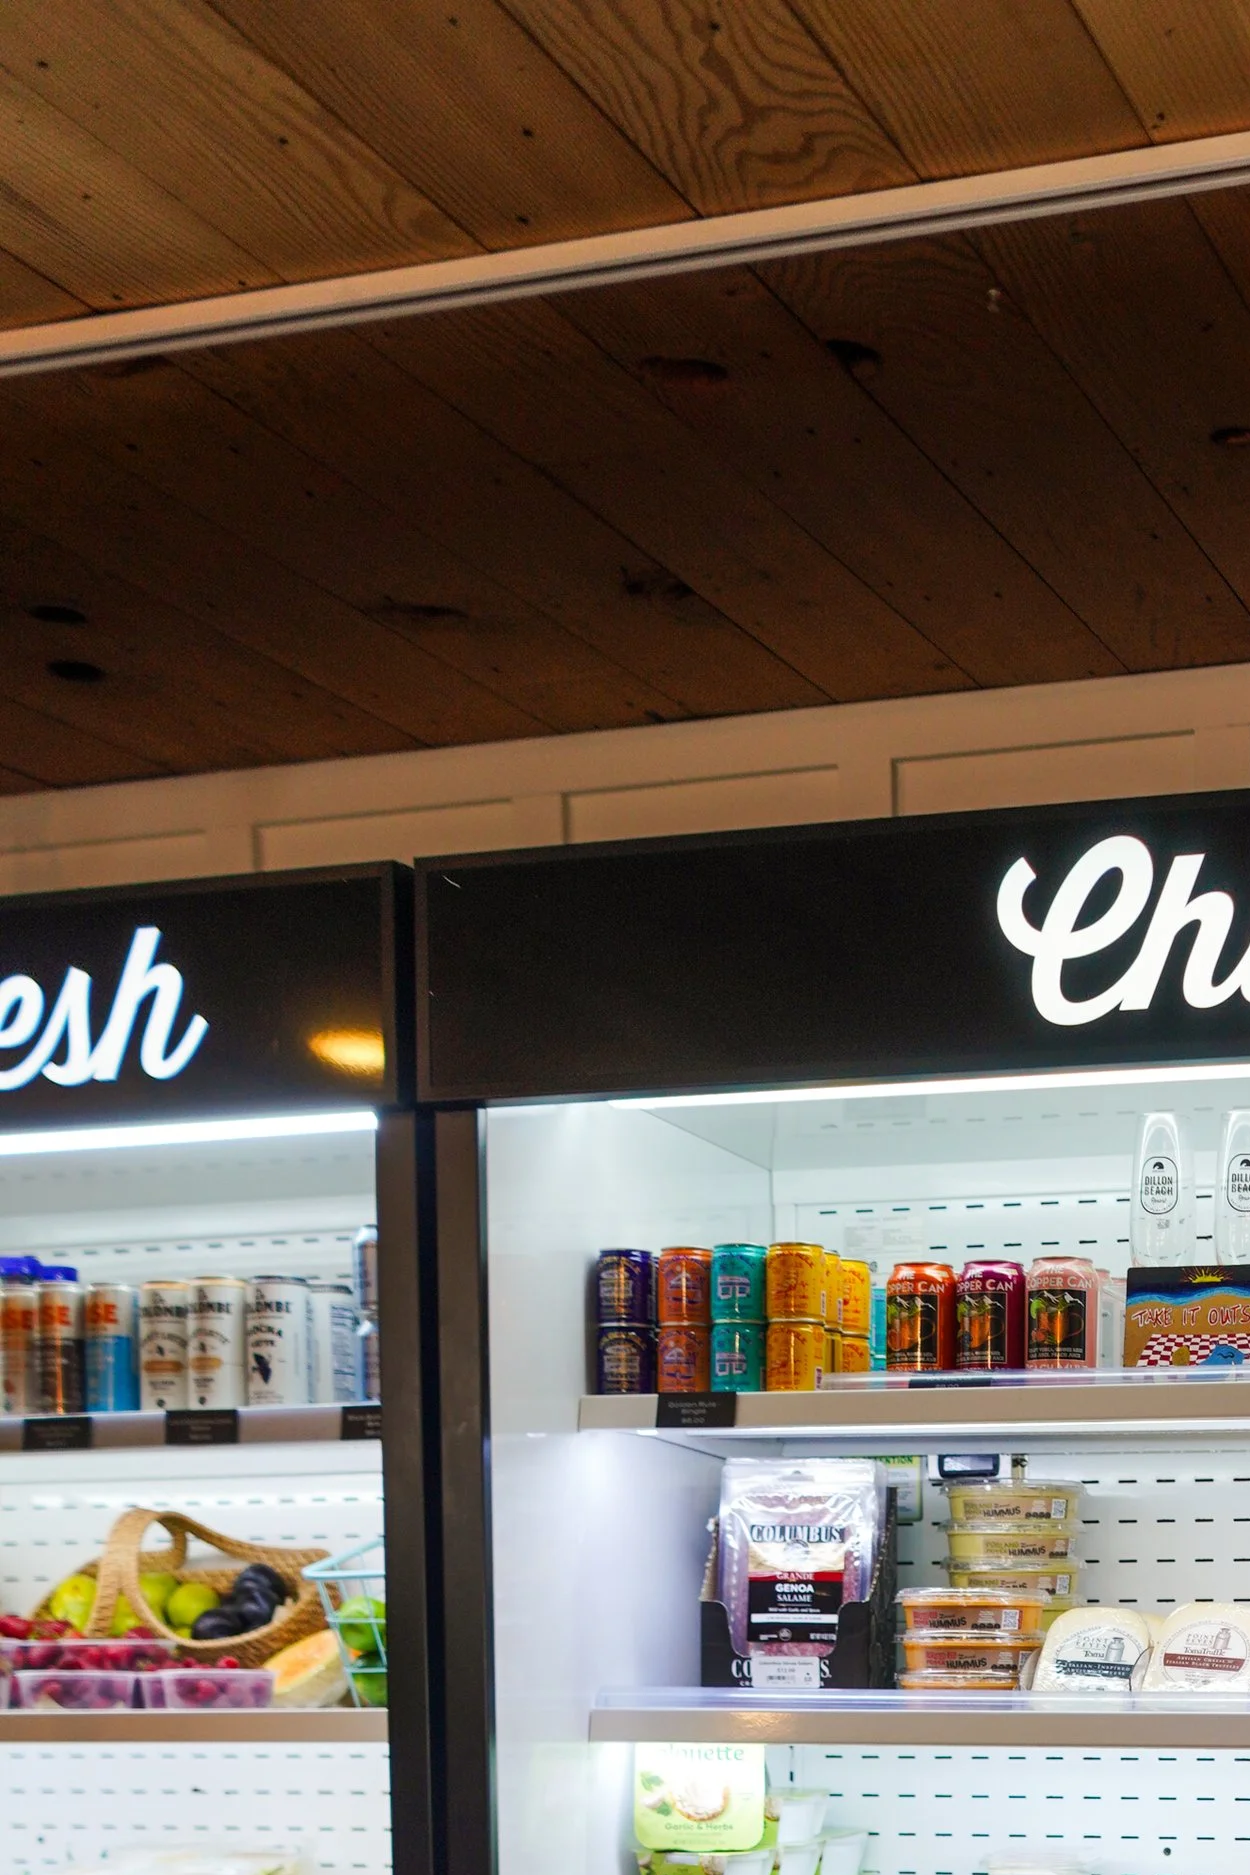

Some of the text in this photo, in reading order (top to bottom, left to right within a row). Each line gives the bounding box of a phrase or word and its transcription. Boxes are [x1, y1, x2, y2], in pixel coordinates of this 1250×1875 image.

[1144, 1176, 1173, 1186] DILLON
[1144, 1186, 1173, 1196] BEACH
[918, 1281, 945, 1293] CAN
[986, 1279, 1013, 1291] CAN
[1068, 1277, 1092, 1288] CAN
[1132, 1308, 1173, 1327] TAKE
[1182, 1306, 1201, 1325] IT
[983, 1506, 1021, 1517] HUMMUS
[1009, 1546, 1046, 1556] HUMMUS
[775, 1572, 815, 1580] GRANDE
[775, 1584, 814, 1593] GENOA
[777, 1594, 812, 1602] SALAME
[929, 1617, 967, 1629] HUMMUS
[1084, 1650, 1105, 1659] Toma
[946, 1658, 987, 1670] HUMMUS
